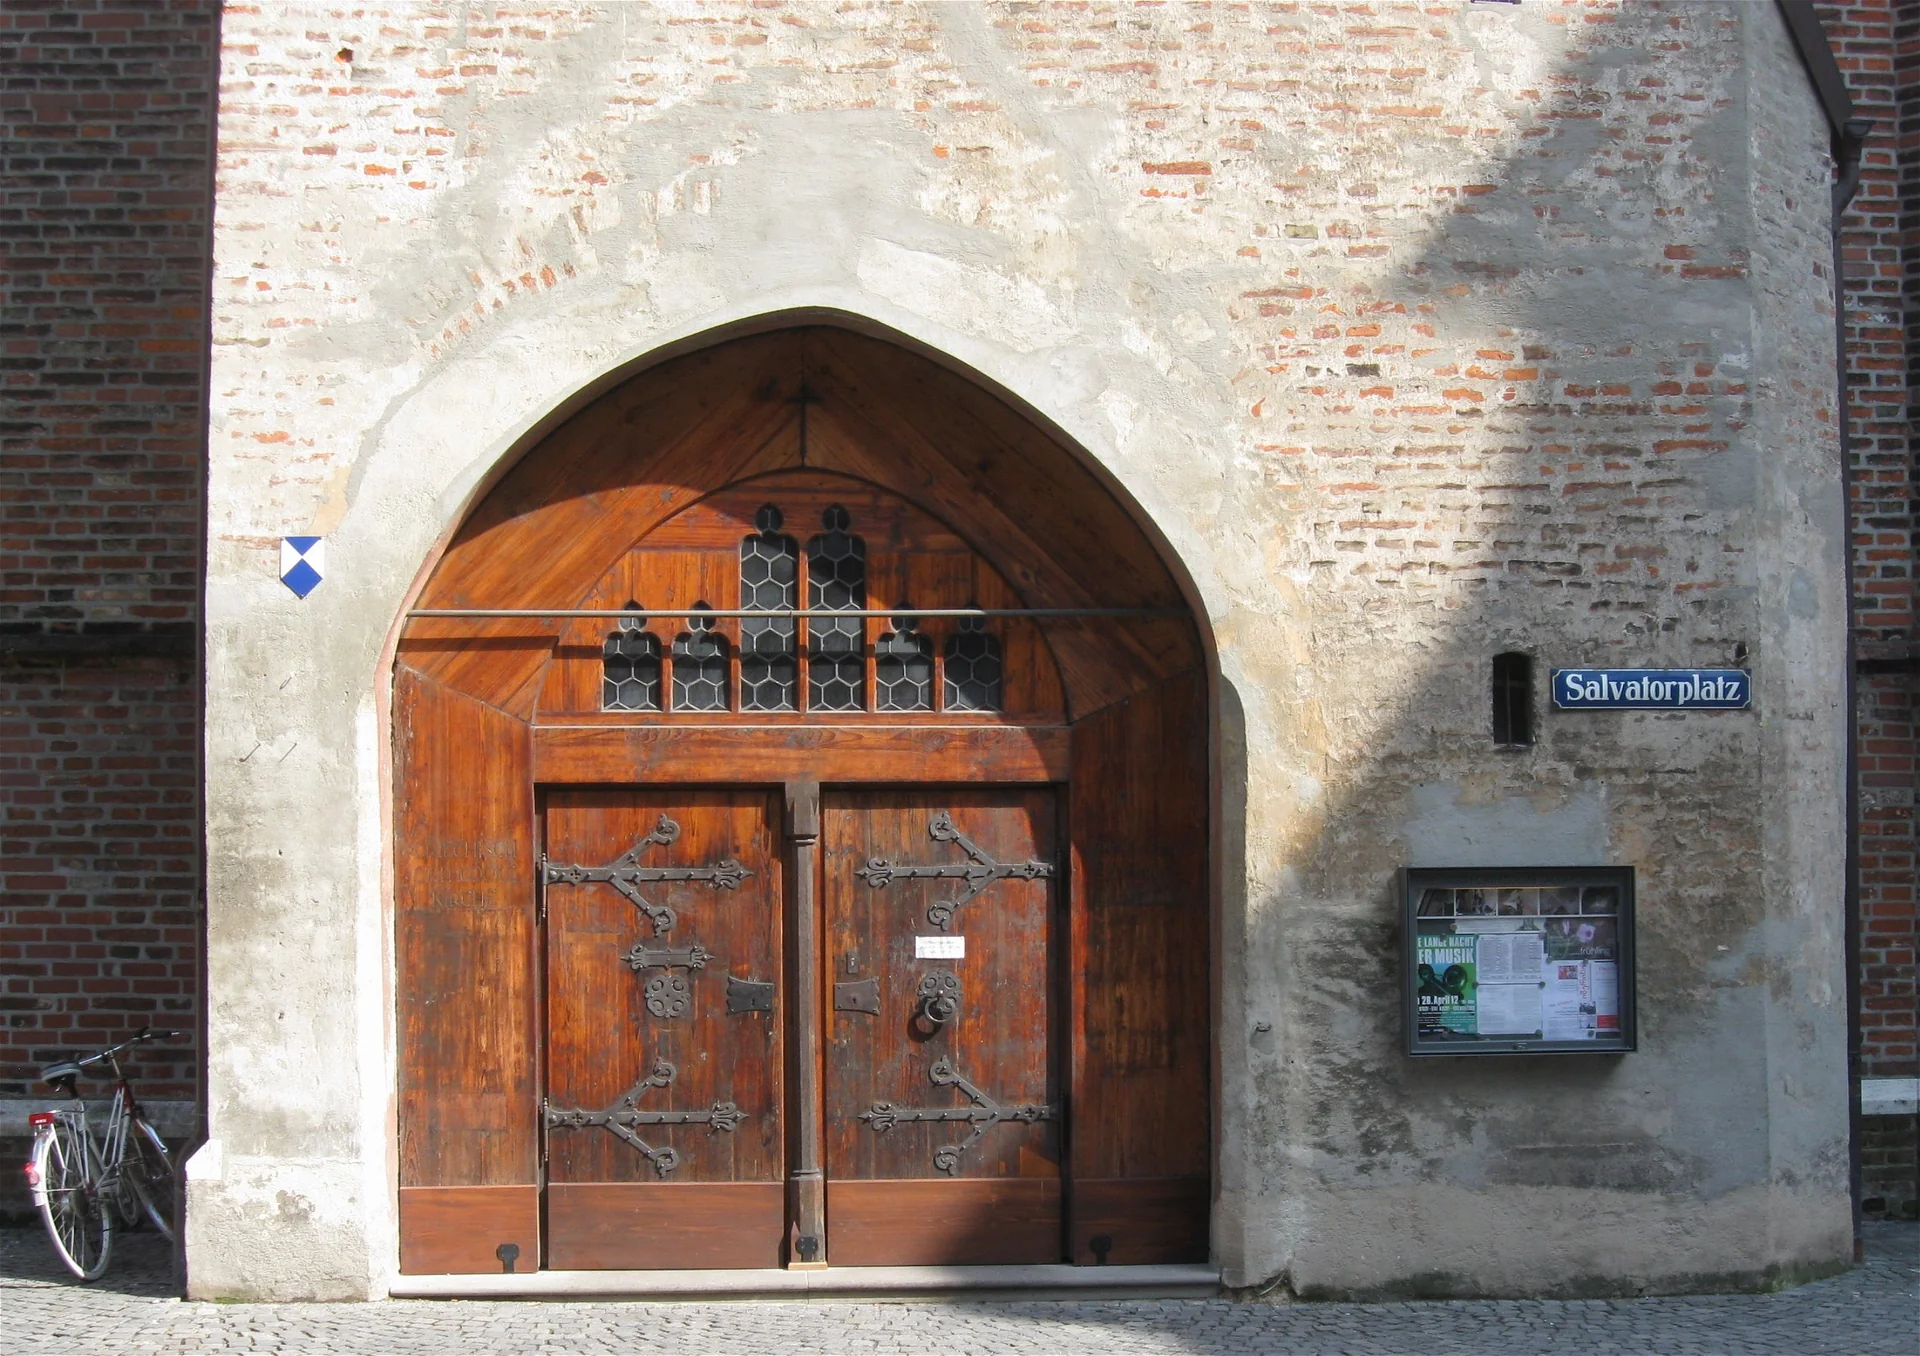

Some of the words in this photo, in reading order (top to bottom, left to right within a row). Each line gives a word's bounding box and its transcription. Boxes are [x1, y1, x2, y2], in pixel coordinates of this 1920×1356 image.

[1565, 673, 1741, 706] Salvatorplatz
[1449, 936, 1475, 947] NACHT
[1435, 948, 1475, 964] MUSIK
